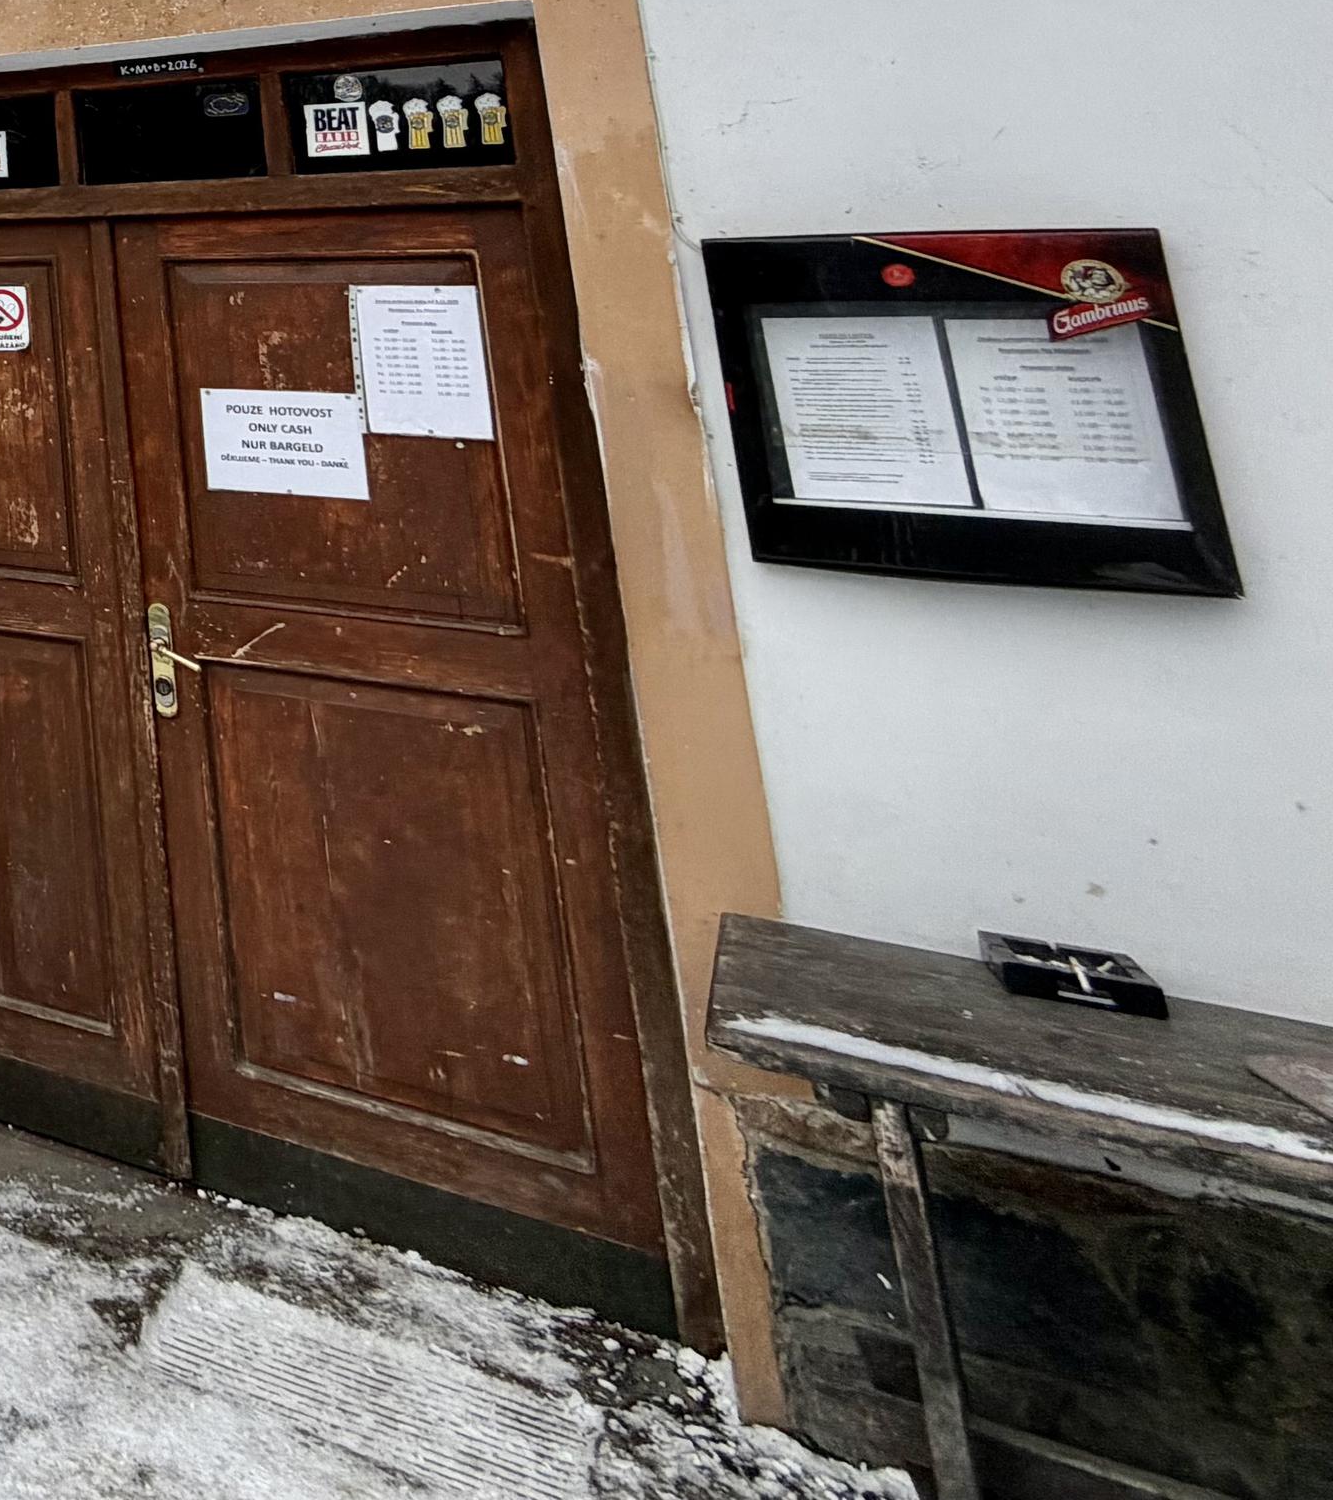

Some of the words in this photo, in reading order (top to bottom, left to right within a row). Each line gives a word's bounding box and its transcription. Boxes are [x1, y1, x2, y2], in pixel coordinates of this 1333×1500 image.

[312, 106, 359, 132] BEAT
[1052, 296, 1150, 334] Gambrinus
[225, 404, 264, 415] POUZE
[269, 406, 334, 418] HOTOVOST
[248, 422, 278, 433] ONLY
[281, 424, 313, 435] CASH
[241, 439, 267, 450] NUR
[269, 440, 324, 453] BARGELD
[268, 457, 295, 465] THANK
[297, 459, 315, 467] YOU
